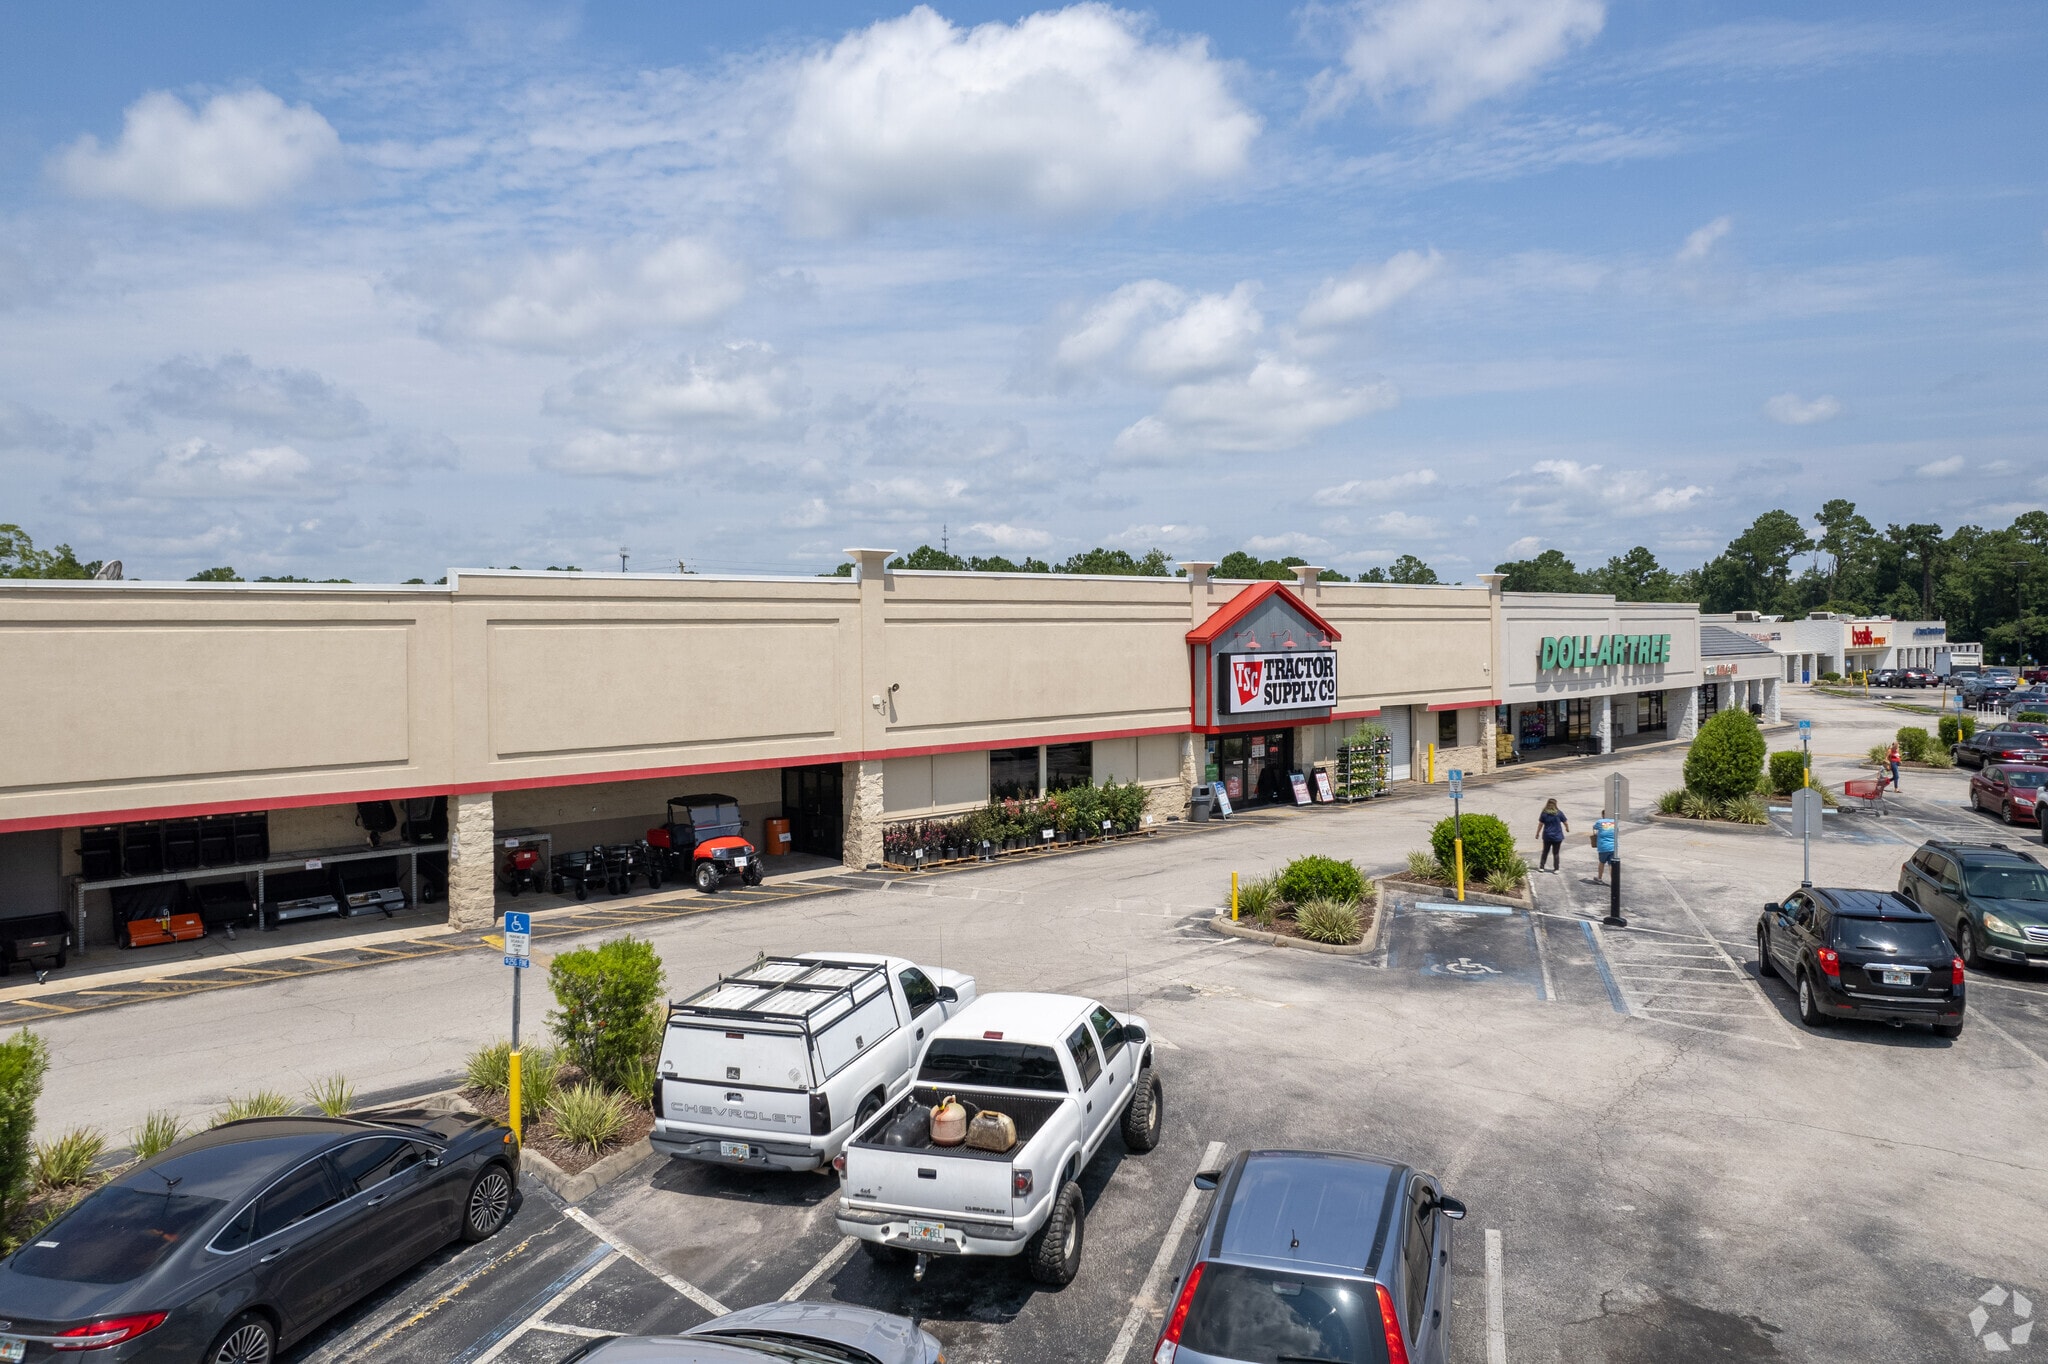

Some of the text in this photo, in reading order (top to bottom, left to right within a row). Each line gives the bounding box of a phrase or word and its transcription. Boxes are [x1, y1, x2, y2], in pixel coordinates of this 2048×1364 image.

[1541, 633, 1671, 670] DOLLAR TREE
[1236, 663, 1258, 697] TSC
[1264, 656, 1334, 681] TRACTOR
[1264, 680, 1318, 706] SUPPLY
[671, 1102, 801, 1124] CHEVROLET
